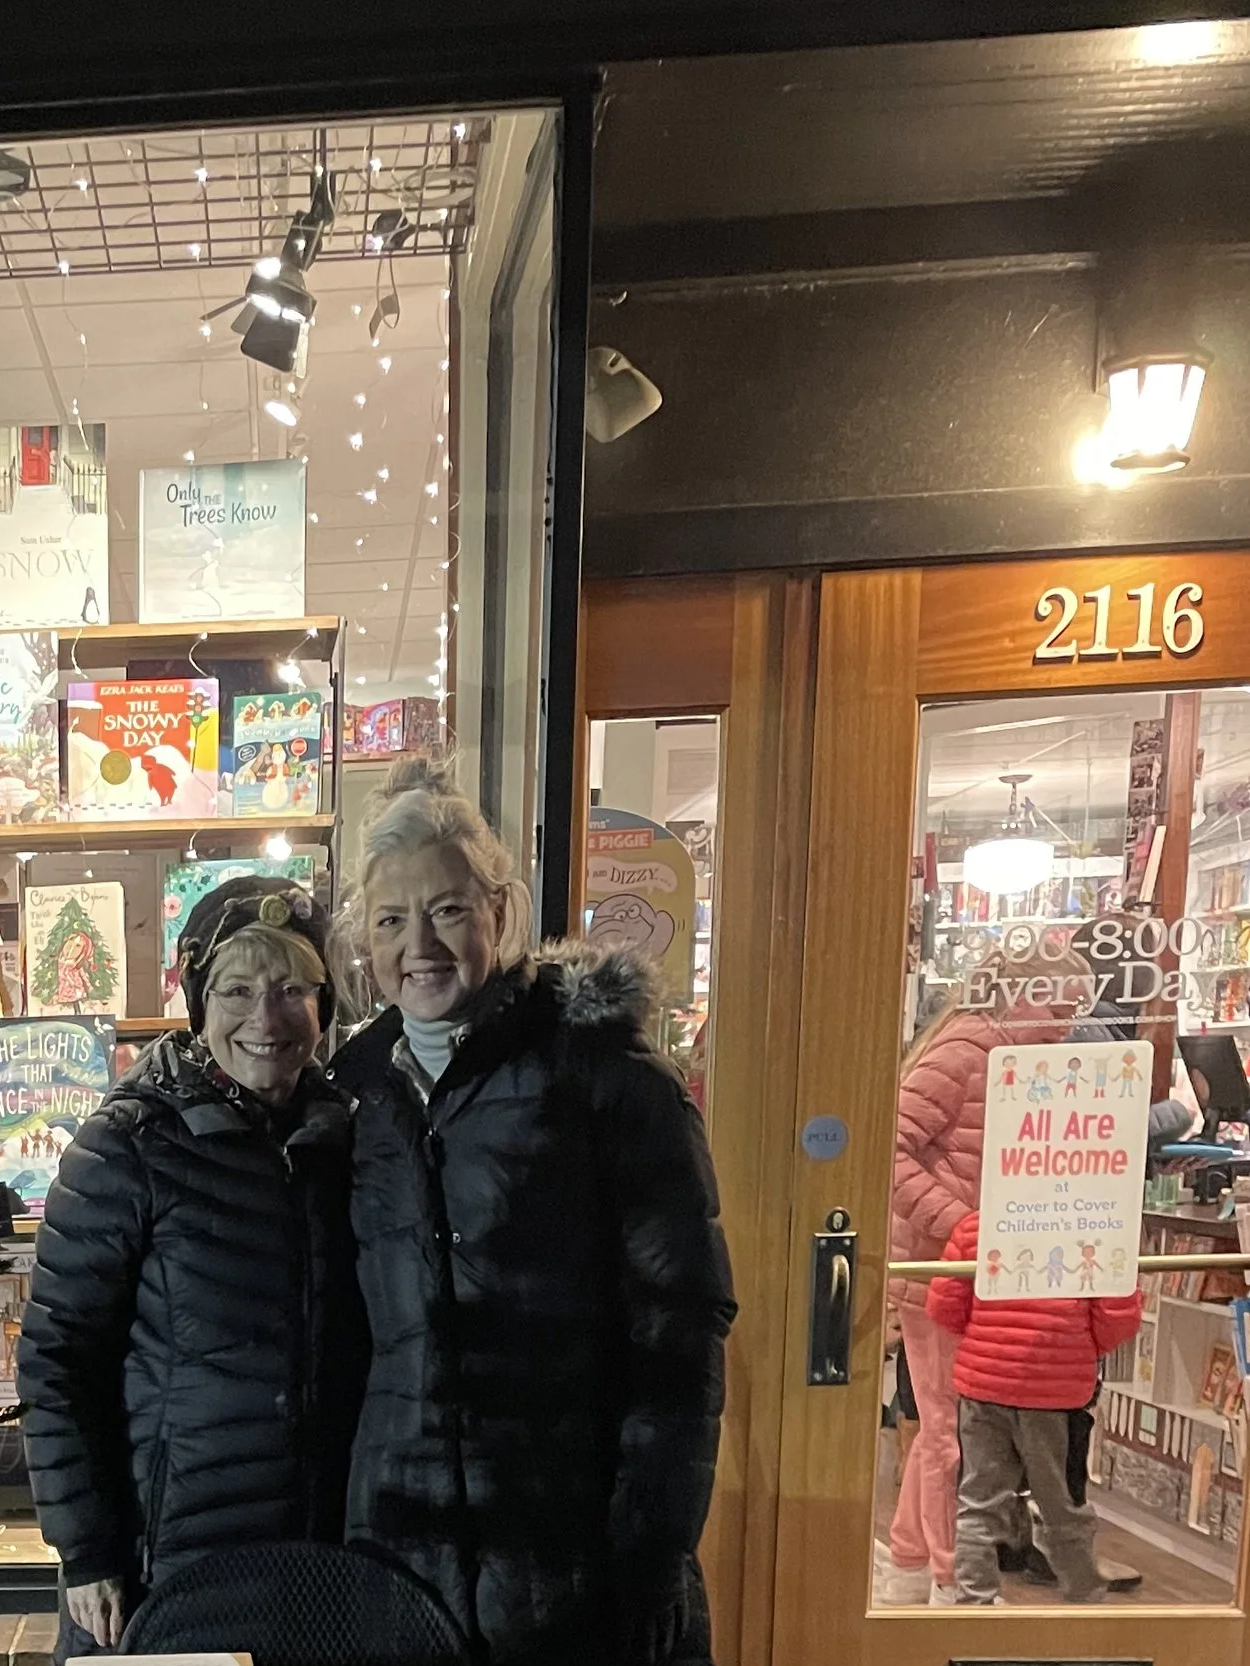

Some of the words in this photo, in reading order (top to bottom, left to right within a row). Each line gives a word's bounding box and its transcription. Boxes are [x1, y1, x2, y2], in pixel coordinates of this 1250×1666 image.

[166, 480, 201, 506] Only
[204, 494, 222, 505] THE
[180, 503, 226, 528] Trees
[231, 501, 277, 524] Know
[1034, 582, 1205, 660] 2116
[100, 686, 126, 696] EZRA
[130, 684, 152, 695] JACK
[155, 683, 185, 694] KEATS
[126, 700, 160, 713] THE
[104, 712, 183, 732] SNOWY
[123, 730, 165, 747] DAY
[599, 832, 650, 850] PIGGIE
[956, 965, 1115, 1018] Every
[1116, 960, 1228, 1012] Day
[26, 1026, 93, 1063] LIGHTS
[20, 1063, 56, 1083] THAT
[30, 1100, 50, 1114] THE
[34, 1089, 44, 1100] IN
[51, 1086, 106, 1117] NIGHT
[1017, 1108, 1053, 1142] All
[1062, 1110, 1115, 1141] Are
[1000, 1145, 1129, 1177] Welcome
[1054, 1181, 1070, 1194] at
[1005, 1200, 1050, 1214] Cover
[1053, 1199, 1069, 1212] to
[1073, 1198, 1118, 1212] Cover
[996, 1218, 1072, 1233] Children's
[1077, 1216, 1124, 1231] Books
